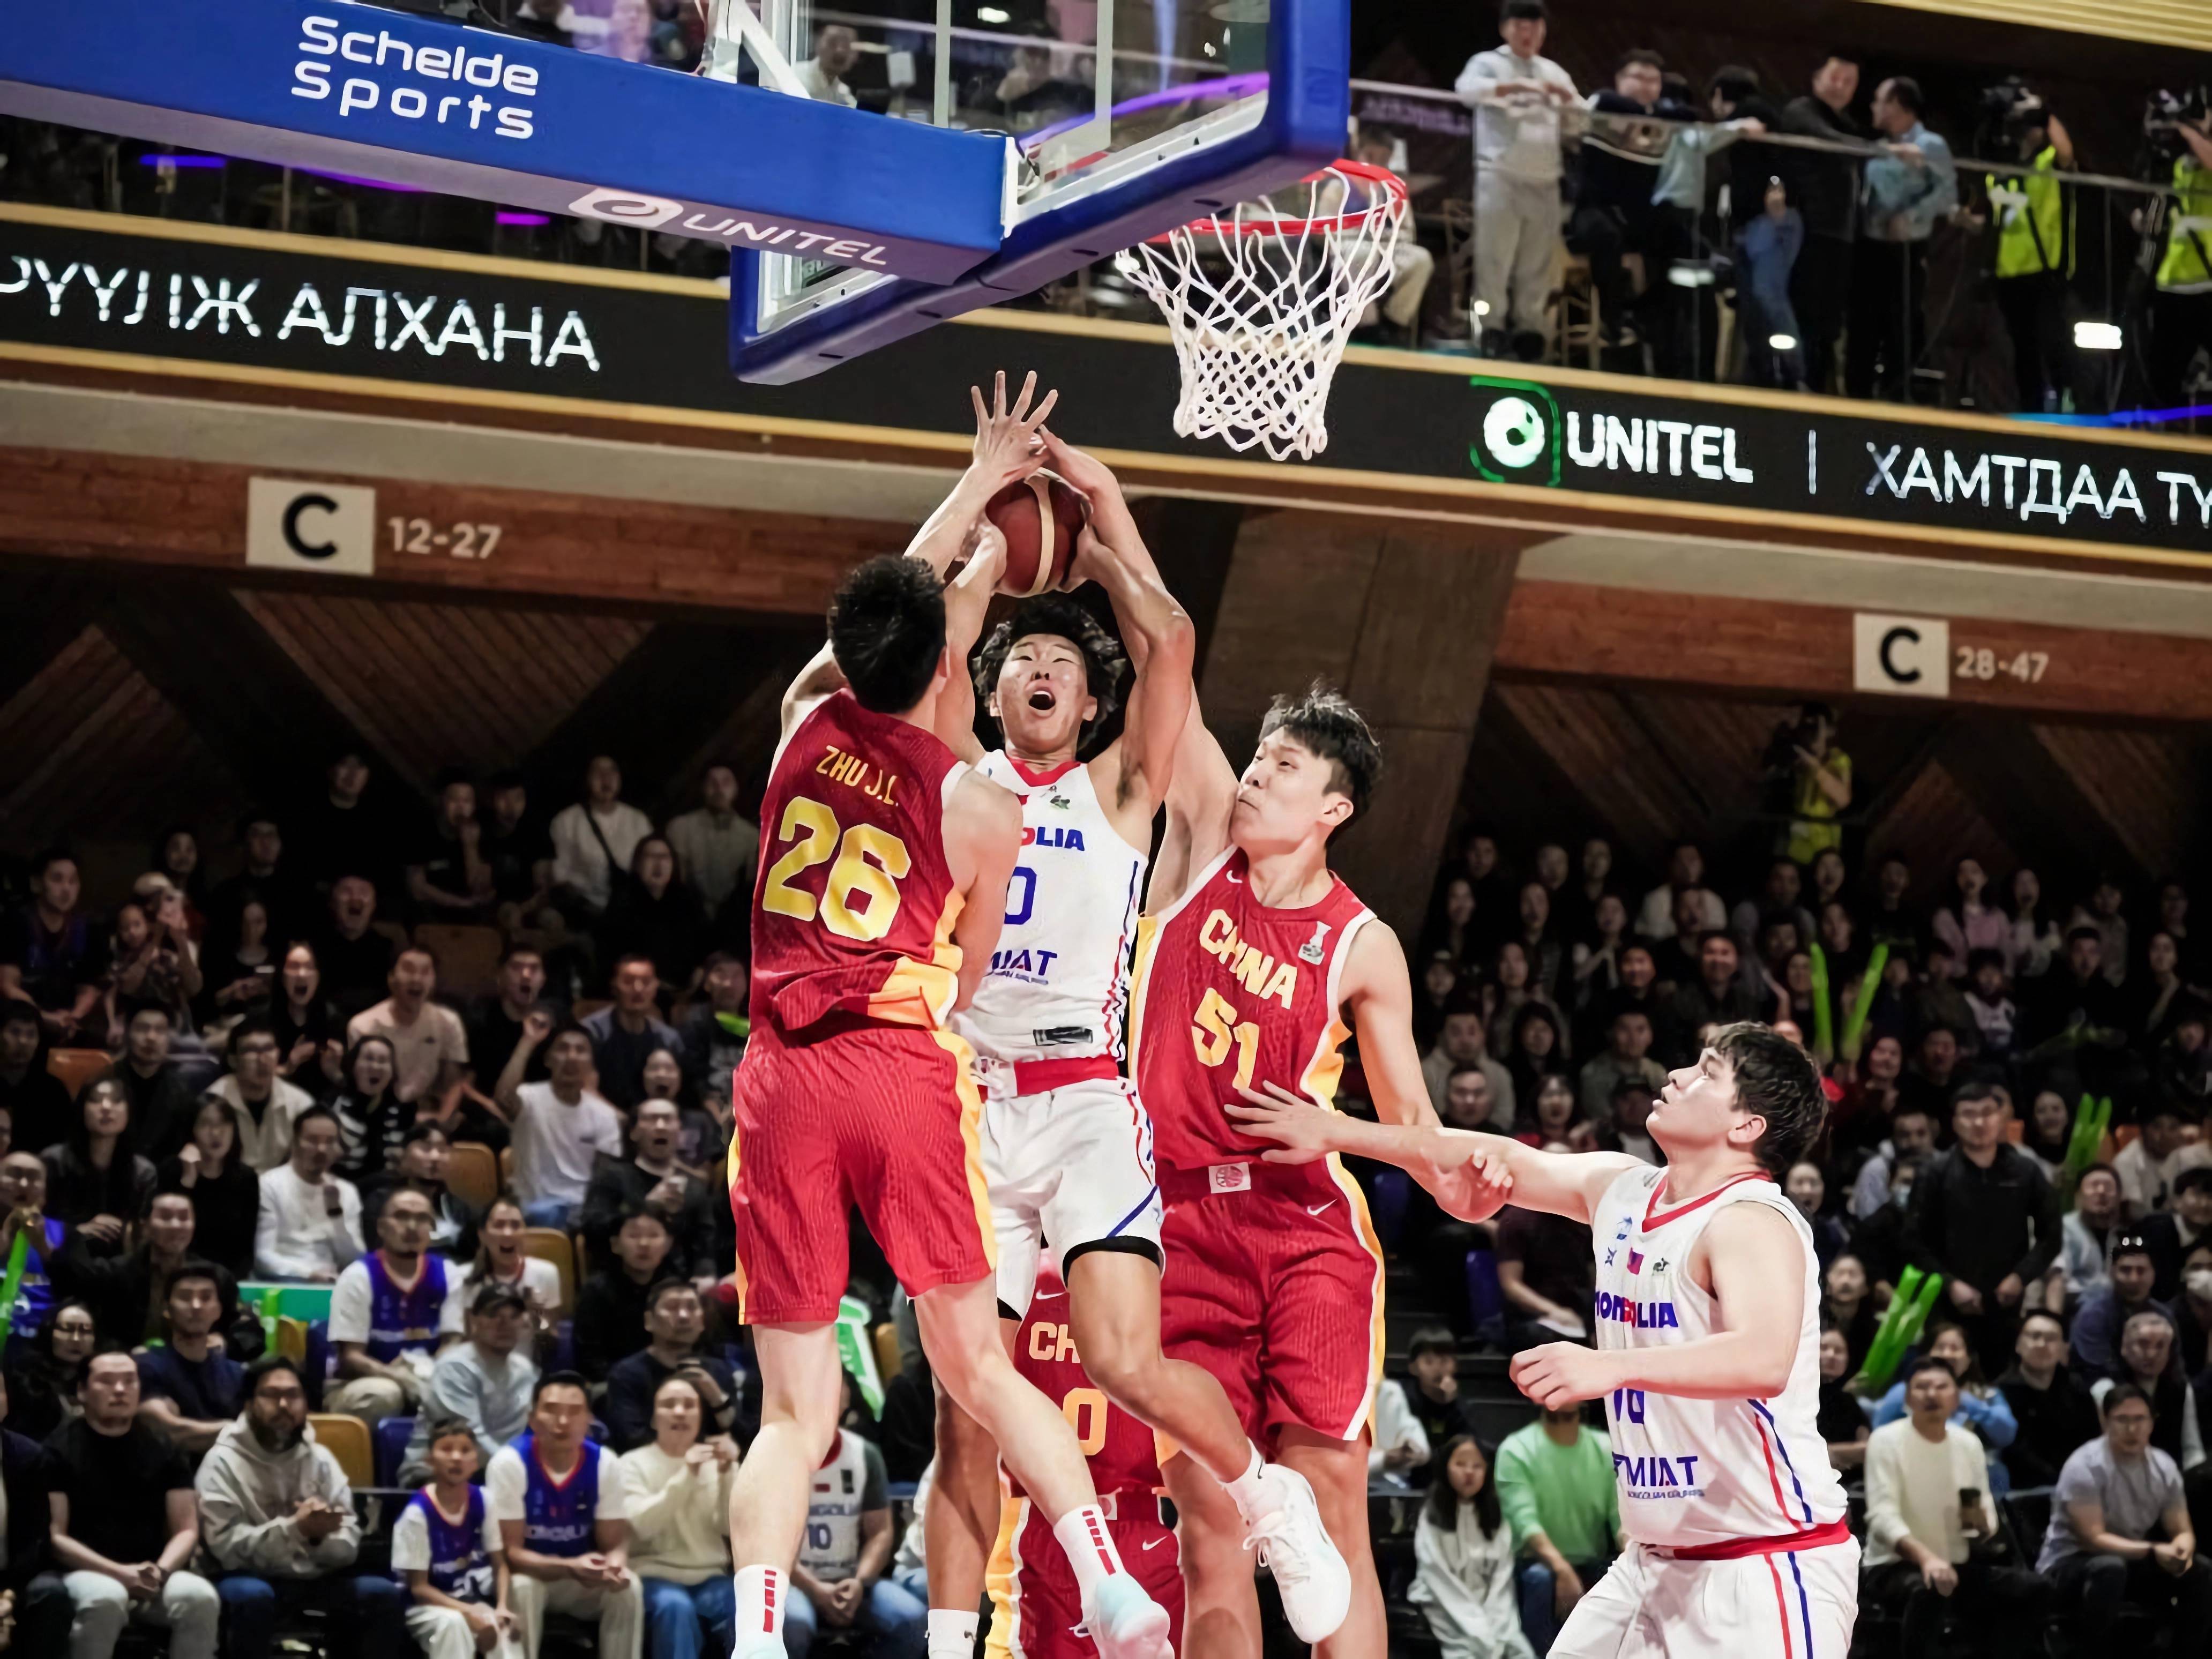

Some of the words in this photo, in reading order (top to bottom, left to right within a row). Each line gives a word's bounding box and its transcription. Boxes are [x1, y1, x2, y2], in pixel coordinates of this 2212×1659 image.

[298, 15, 538, 96] Schelde
[291, 59, 534, 140] Sports
[683, 213, 887, 266] UNITEL
[278, 282, 601, 372] АЛХАНА
[1567, 411, 1754, 484] UNITEL
[1865, 440, 2147, 525] ХАМТДАА
[282, 492, 339, 560] C
[387, 517, 502, 560] 12-27
[1879, 626, 1923, 684] C
[1955, 646, 2049, 683] 28-47
[816, 744, 869, 787] ZHU
[762, 796, 911, 941] 26
[1199, 909, 1297, 1010] CHINA
[1191, 988, 1260, 1090] 51
[1063, 1387, 1108, 1456] 0
